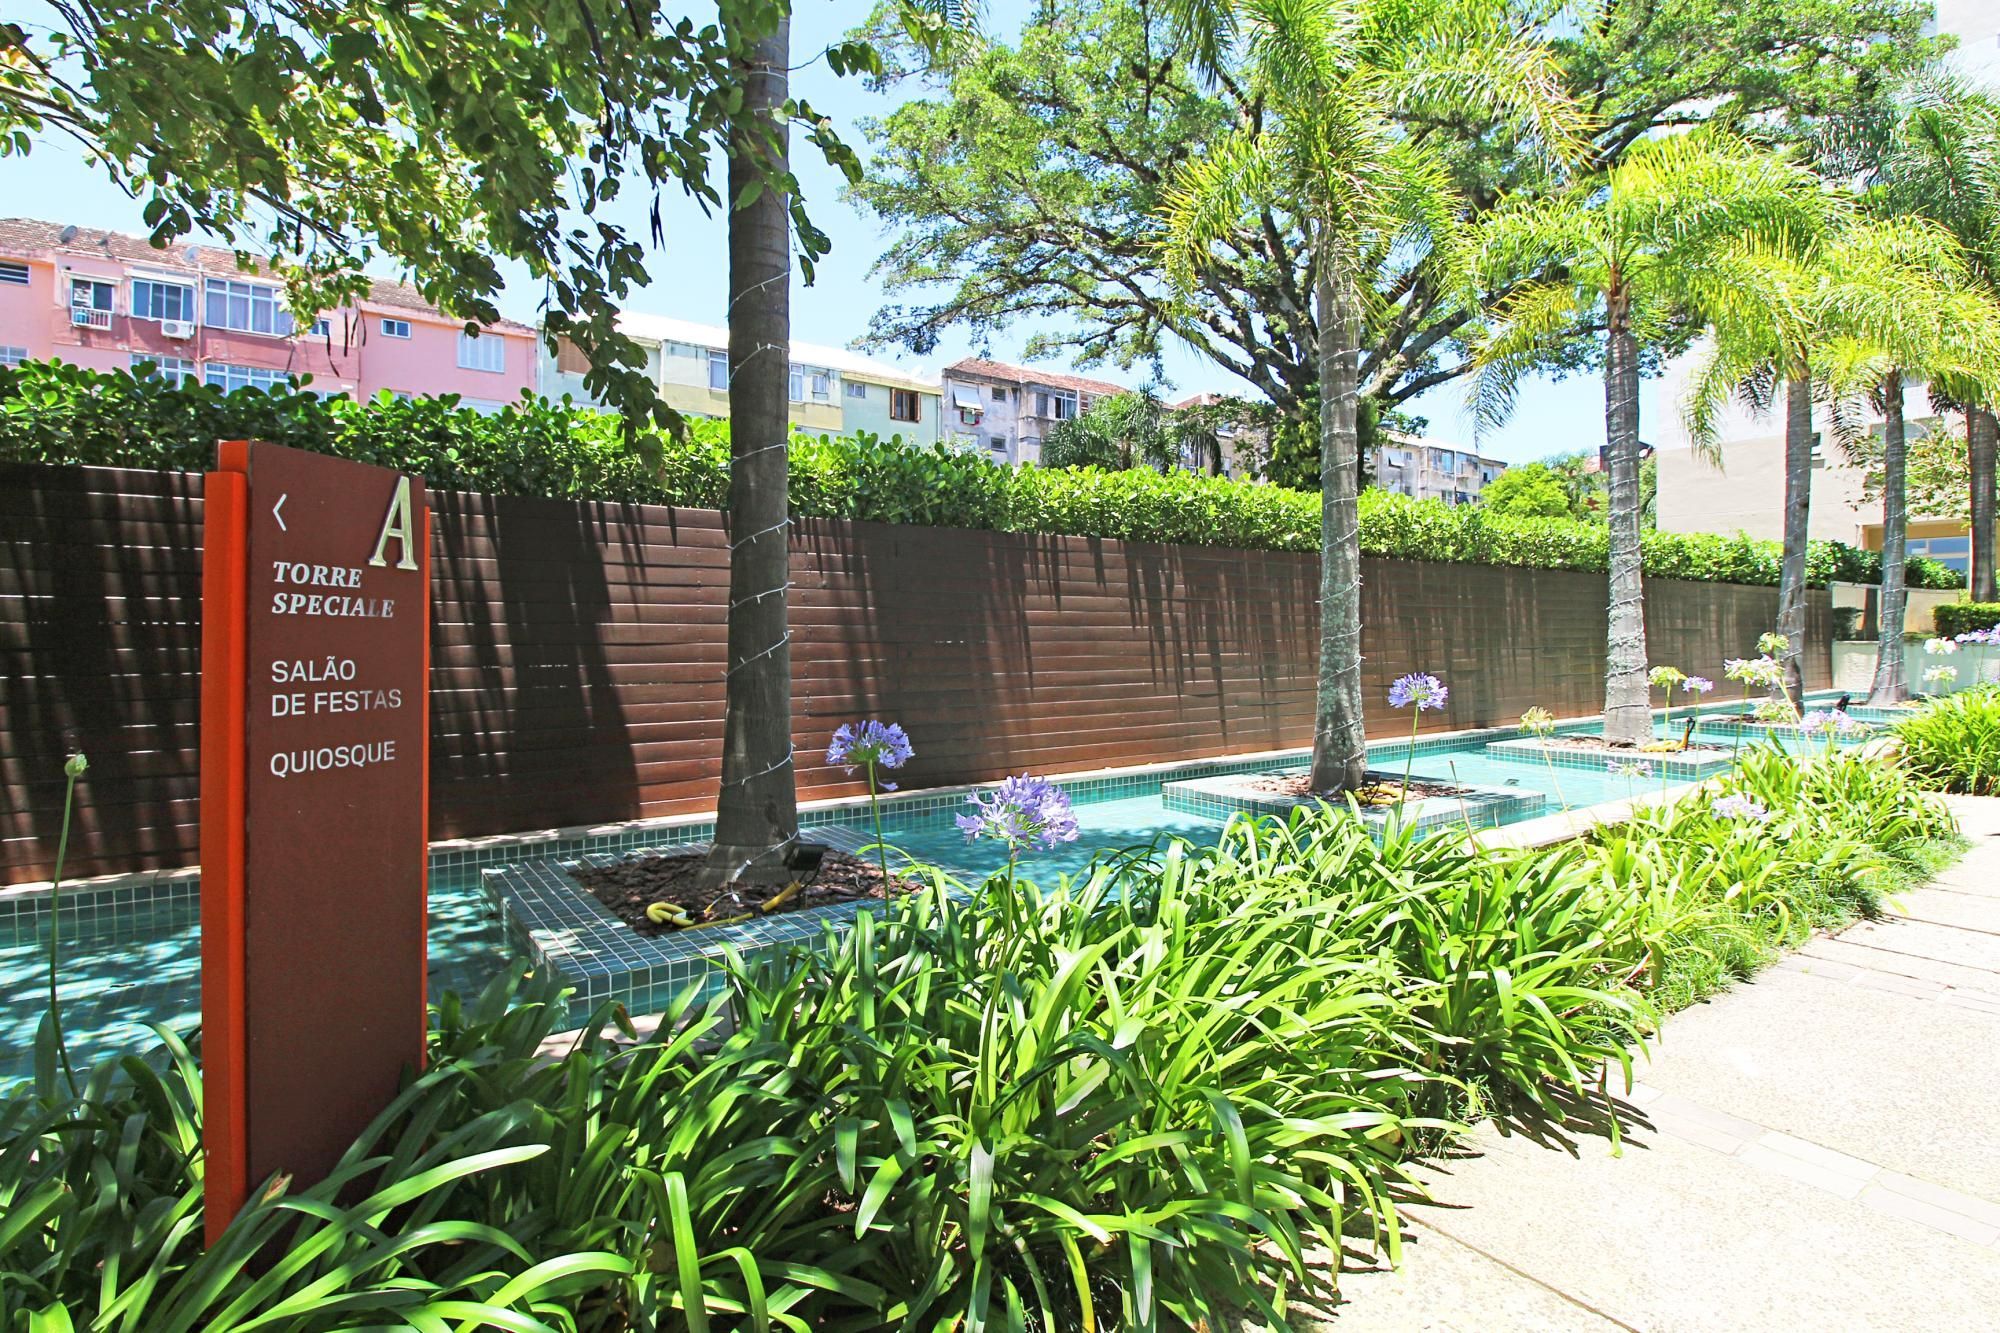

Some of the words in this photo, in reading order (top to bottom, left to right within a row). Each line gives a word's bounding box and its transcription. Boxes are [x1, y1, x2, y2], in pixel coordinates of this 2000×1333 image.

[368, 475, 418, 570] A
[273, 561, 362, 588] TORRE
[271, 593, 394, 618] SPECIALE
[271, 656, 356, 683] SALÃO
[271, 693, 306, 717] DE
[314, 689, 401, 714] FESTAS
[270, 741, 396, 778] QUIOSQUE
